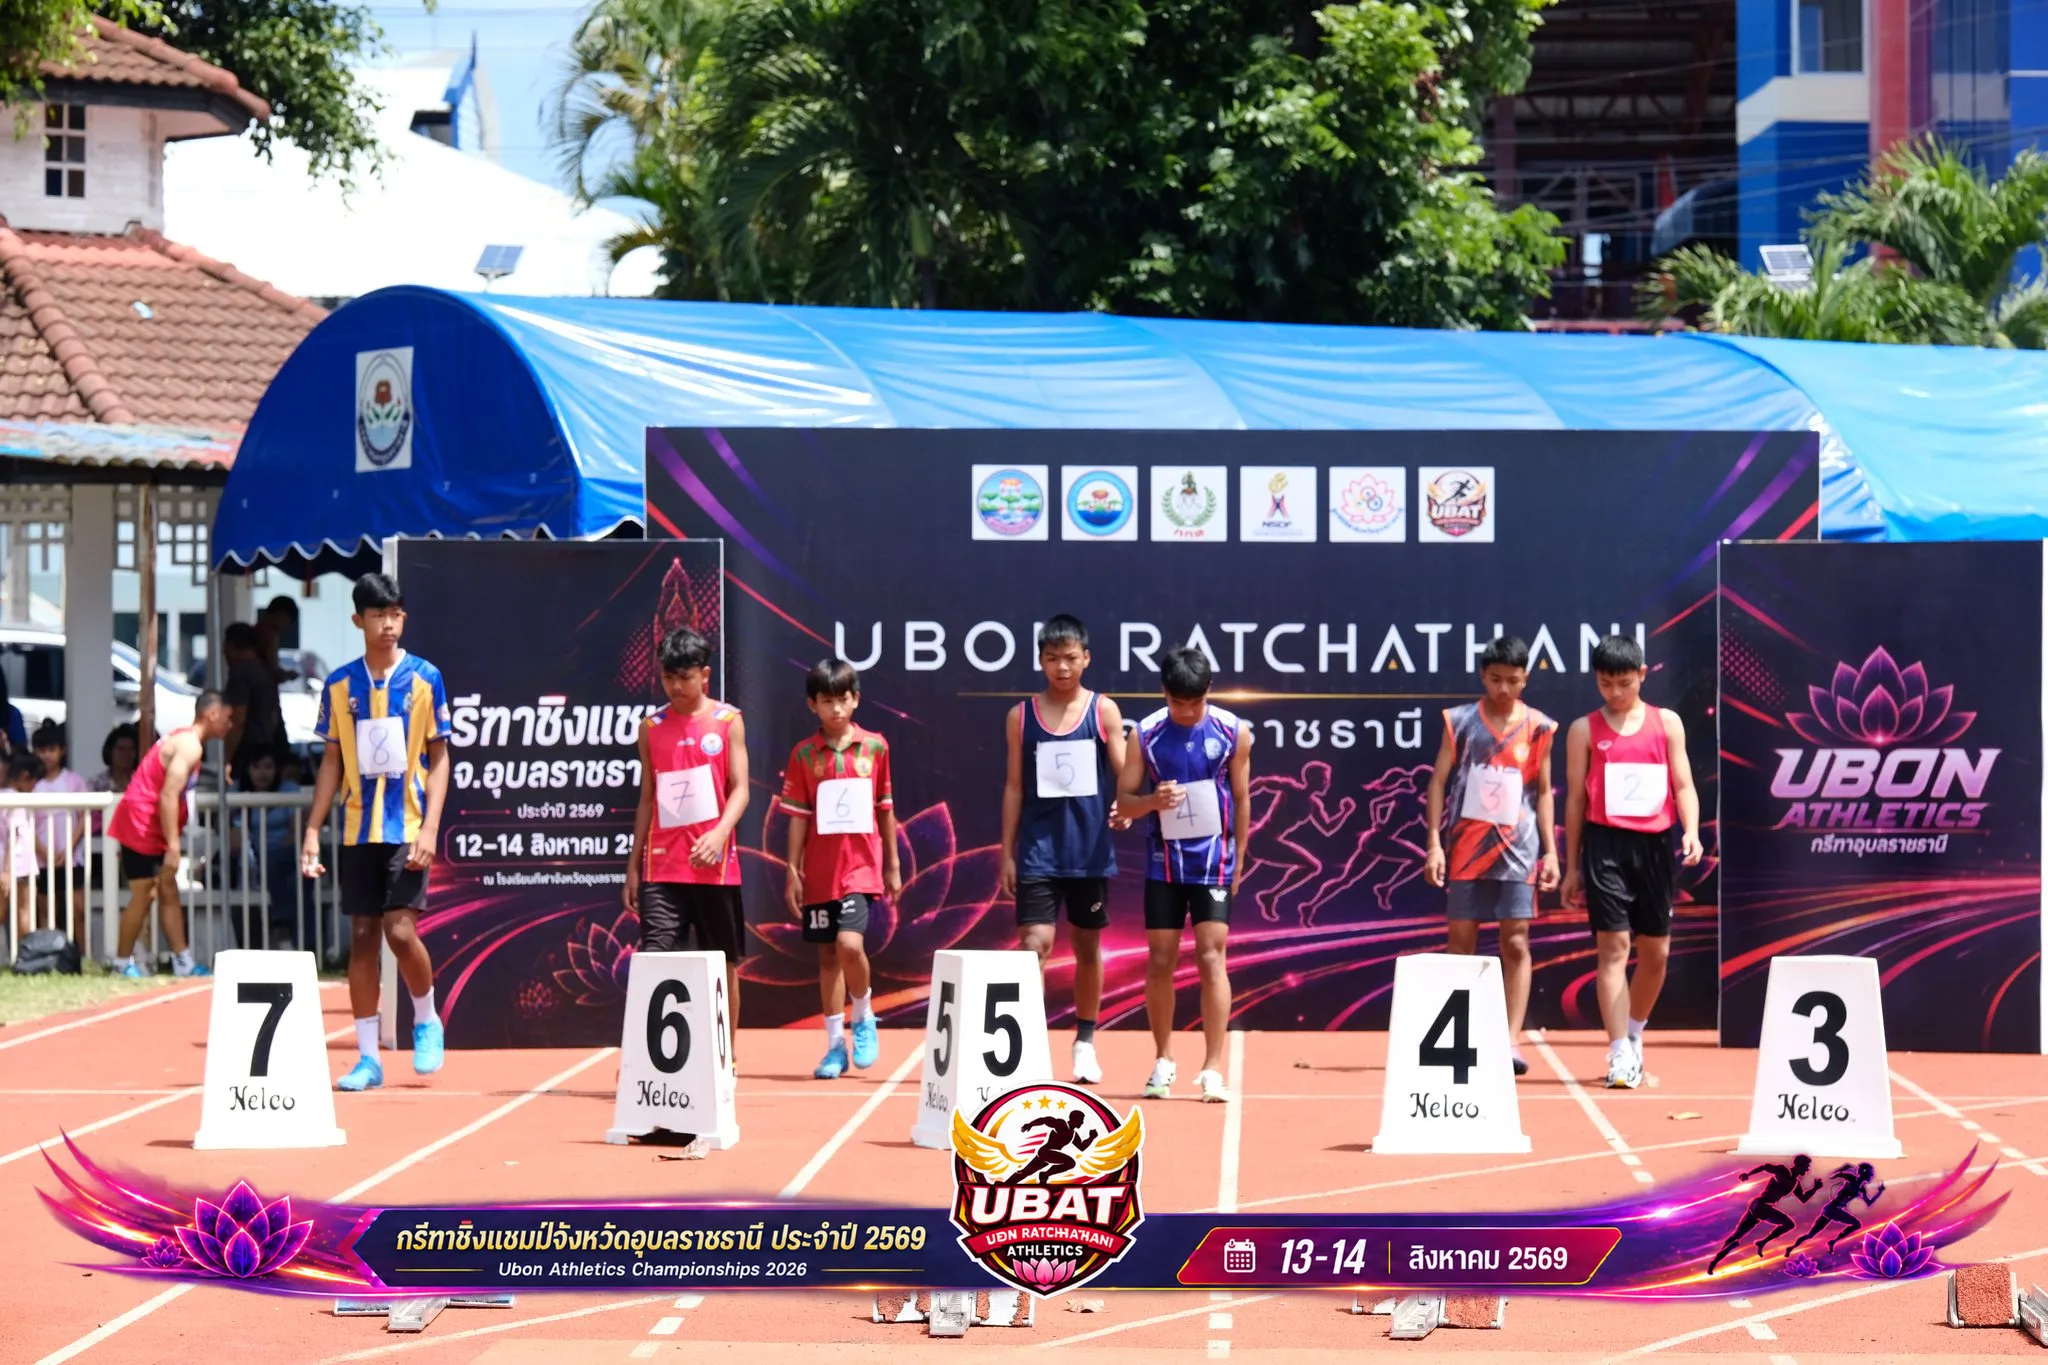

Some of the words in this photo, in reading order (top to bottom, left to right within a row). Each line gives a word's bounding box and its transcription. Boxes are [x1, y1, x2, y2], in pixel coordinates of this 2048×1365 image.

[369, 726, 390, 765] 8
[1054, 752, 1076, 787] 5
[1770, 748, 2002, 798] UBON
[670, 780, 695, 815] 7
[835, 787, 851, 819] 6
[1480, 780, 1503, 813] 3
[1622, 773, 1645, 802] 2
[568, 803, 605, 819] 2569
[1176, 791, 1199, 827] 4
[1772, 802, 1990, 830] ATHLETICS
[456, 833, 524, 857] 12-14
[530, 832, 609, 856] สิงหาคม
[809, 909, 830, 929] 16
[237, 982, 293, 1077] 7
[646, 979, 691, 1074] 6
[715, 977, 726, 1070] 6
[933, 981, 955, 1077] 5
[982, 982, 1023, 1077] 5
[1419, 989, 1477, 1084] 4
[1788, 990, 1850, 1086] 3
[229, 1086, 296, 1110] Nelco
[637, 1080, 691, 1109] Nelco
[1410, 1092, 1480, 1119] Nelco
[1777, 1093, 1850, 1122] Nelco
